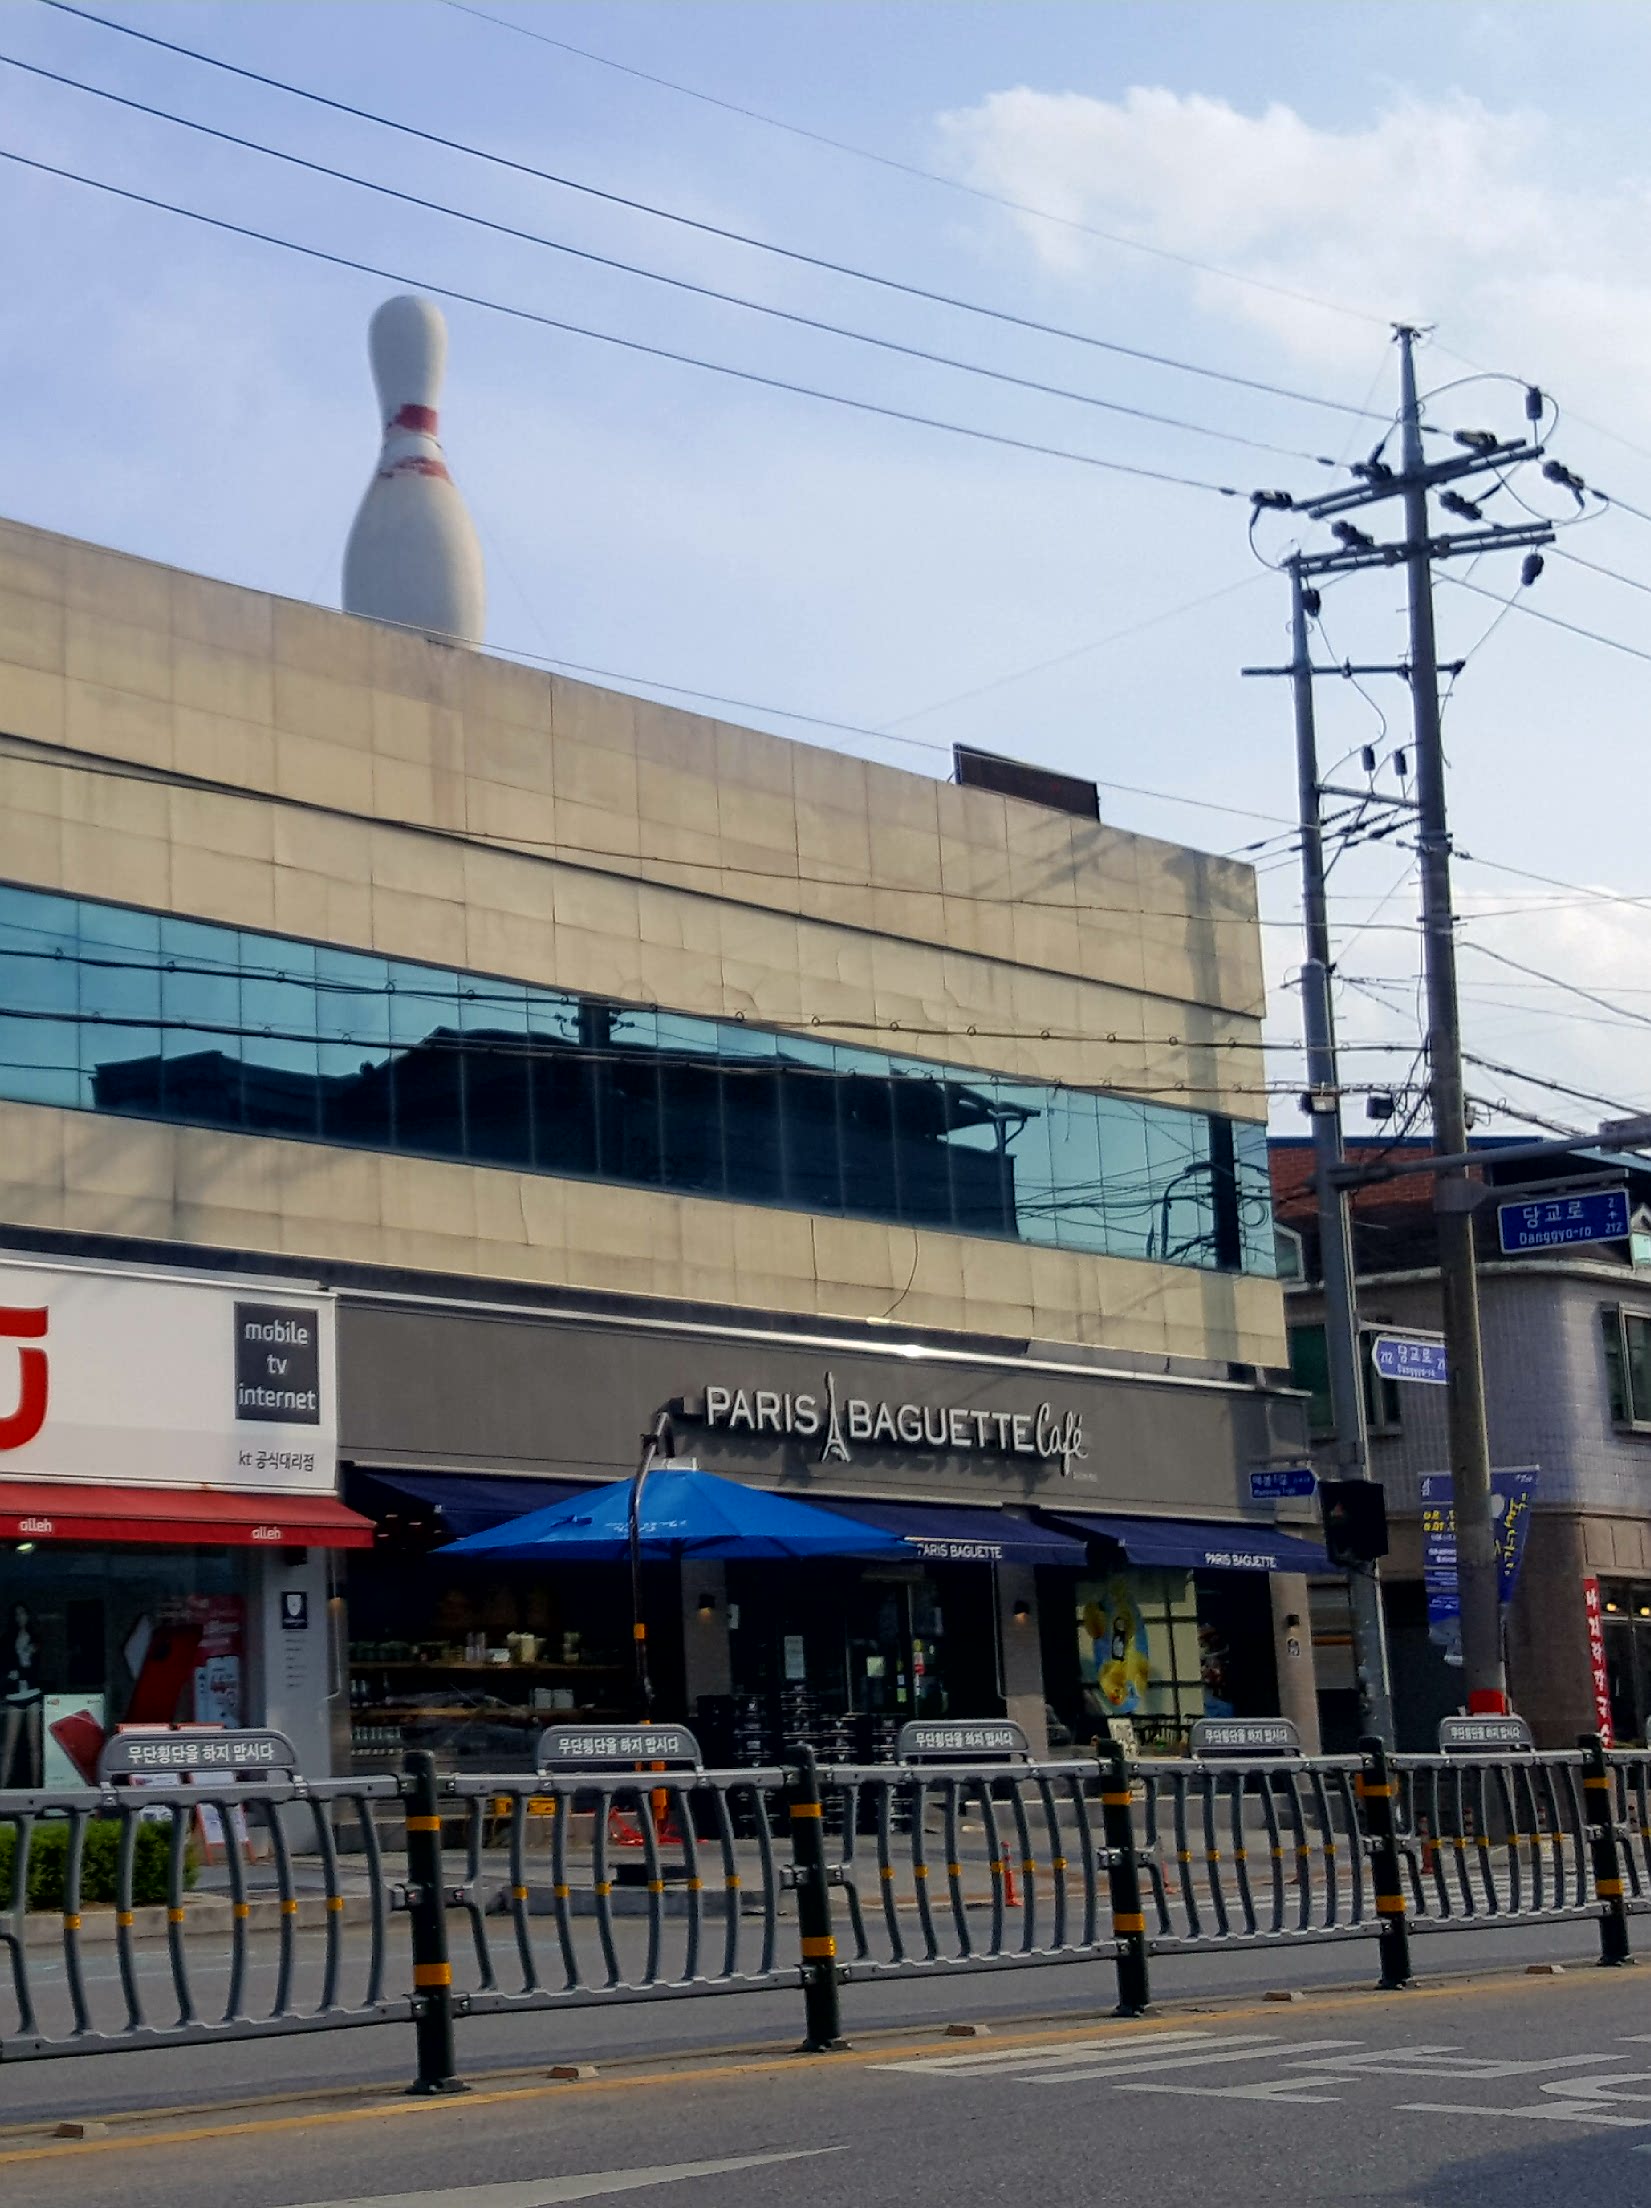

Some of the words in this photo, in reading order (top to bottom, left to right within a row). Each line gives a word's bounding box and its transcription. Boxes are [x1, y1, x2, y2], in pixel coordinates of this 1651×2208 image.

[1522, 1200, 1585, 1228] 당교로
[1519, 1225, 1592, 1246] Danggyo-ro
[244, 1320, 309, 1345] mobile
[266, 1354, 288, 1375] tv
[1397, 1345, 1432, 1364] 당교로
[238, 1383, 317, 1411] internet
[705, 1385, 820, 1435] PARIS
[846, 1398, 1036, 1452] BAGUETTE
[1035, 1401, 1089, 1477] Café
[238, 1450, 252, 1467] kt
[255, 1450, 315, 1472] 공식대리점
[19, 1518, 53, 1533] olleh
[252, 1527, 283, 1541] olleh
[916, 1543, 948, 1557] PARIS
[950, 1545, 1002, 1559] BAGUETTE
[1204, 1552, 1231, 1566] PARIS
[1232, 1554, 1277, 1568] BAGUETTE
[127, 1744, 199, 1764] 무단횡단을
[202, 1743, 230, 1762] 하지
[233, 1742, 275, 1762] 맙시다
[558, 1736, 617, 1755] 무단횡단을
[620, 1736, 643, 1754] 하지
[645, 1735, 679, 1754] 맙시다
